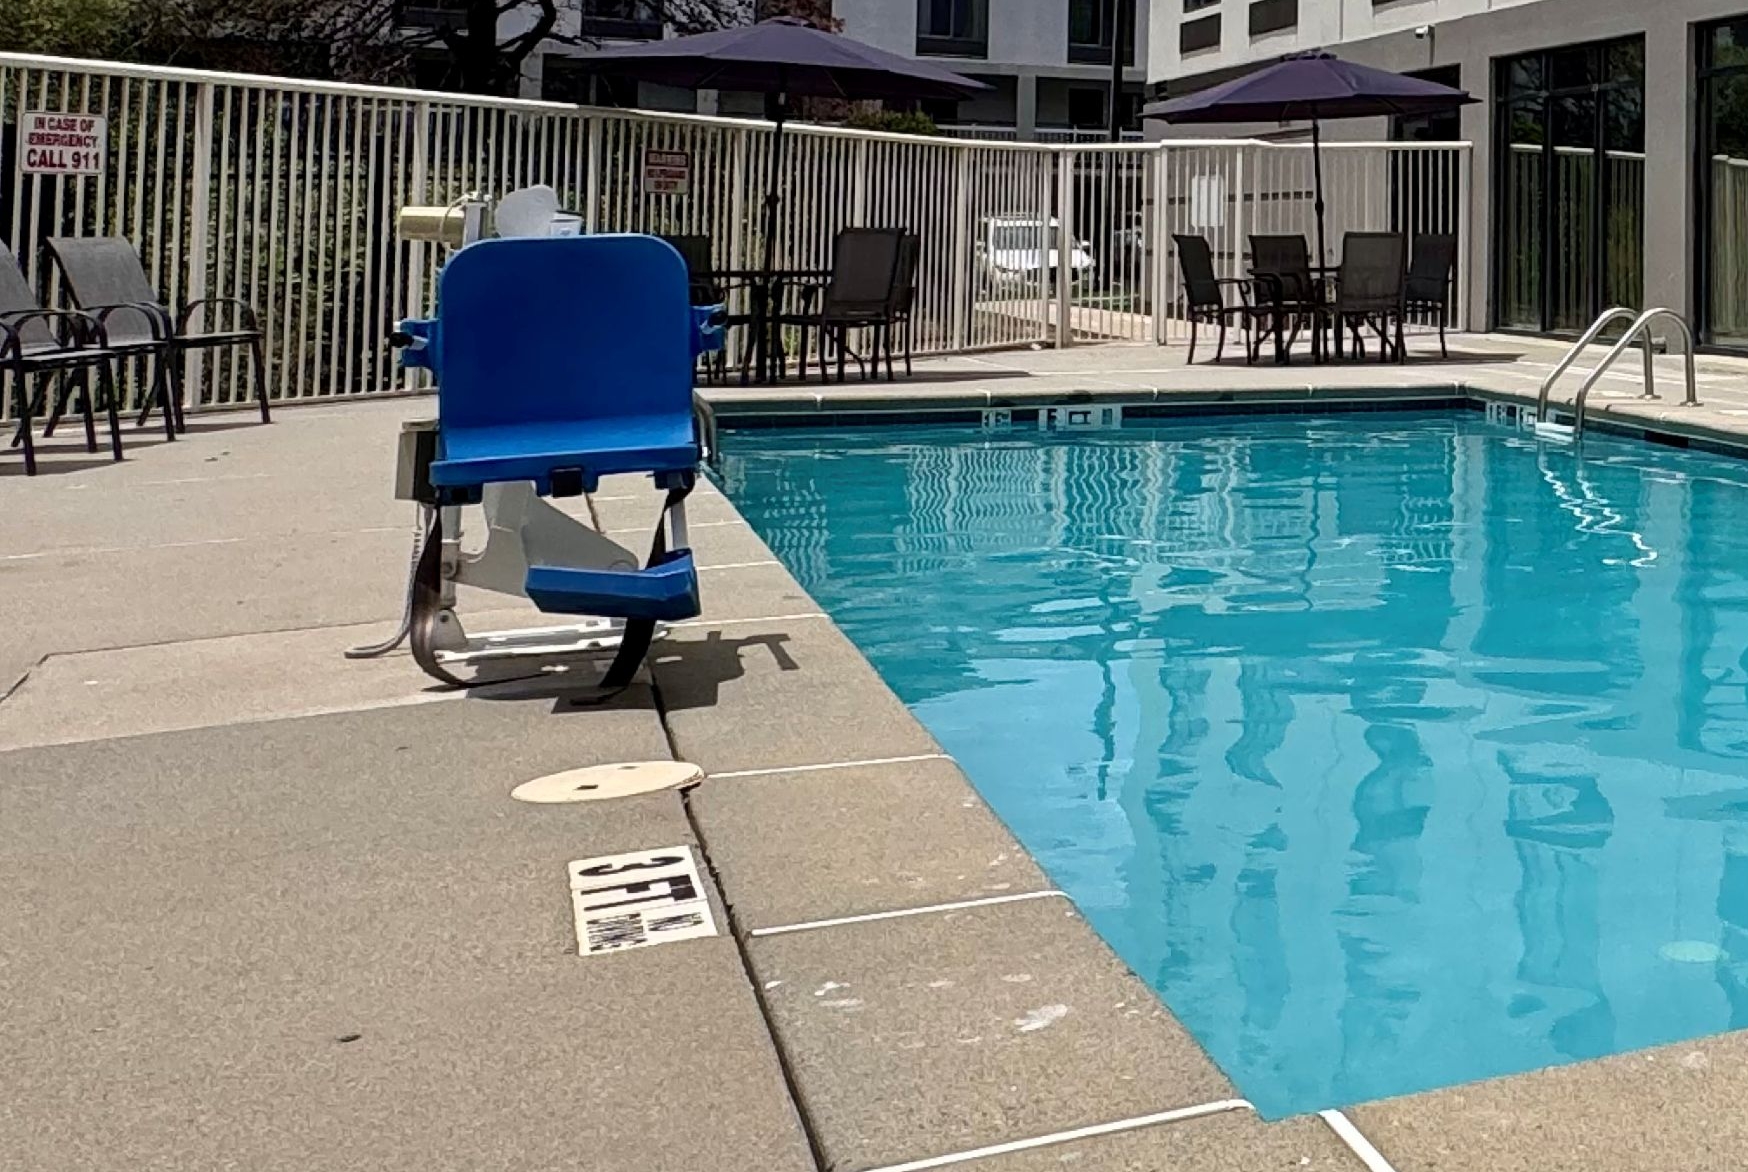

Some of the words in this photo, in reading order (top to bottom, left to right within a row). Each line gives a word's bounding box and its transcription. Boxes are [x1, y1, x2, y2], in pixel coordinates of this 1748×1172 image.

[34, 117, 46, 130] IN
[47, 117, 78, 132] CASE
[80, 118, 95, 133] OF
[28, 132, 98, 148] EMERGENCY
[26, 148, 67, 169] CALL
[71, 151, 100, 170] 911
[580, 873, 698, 912] FT
